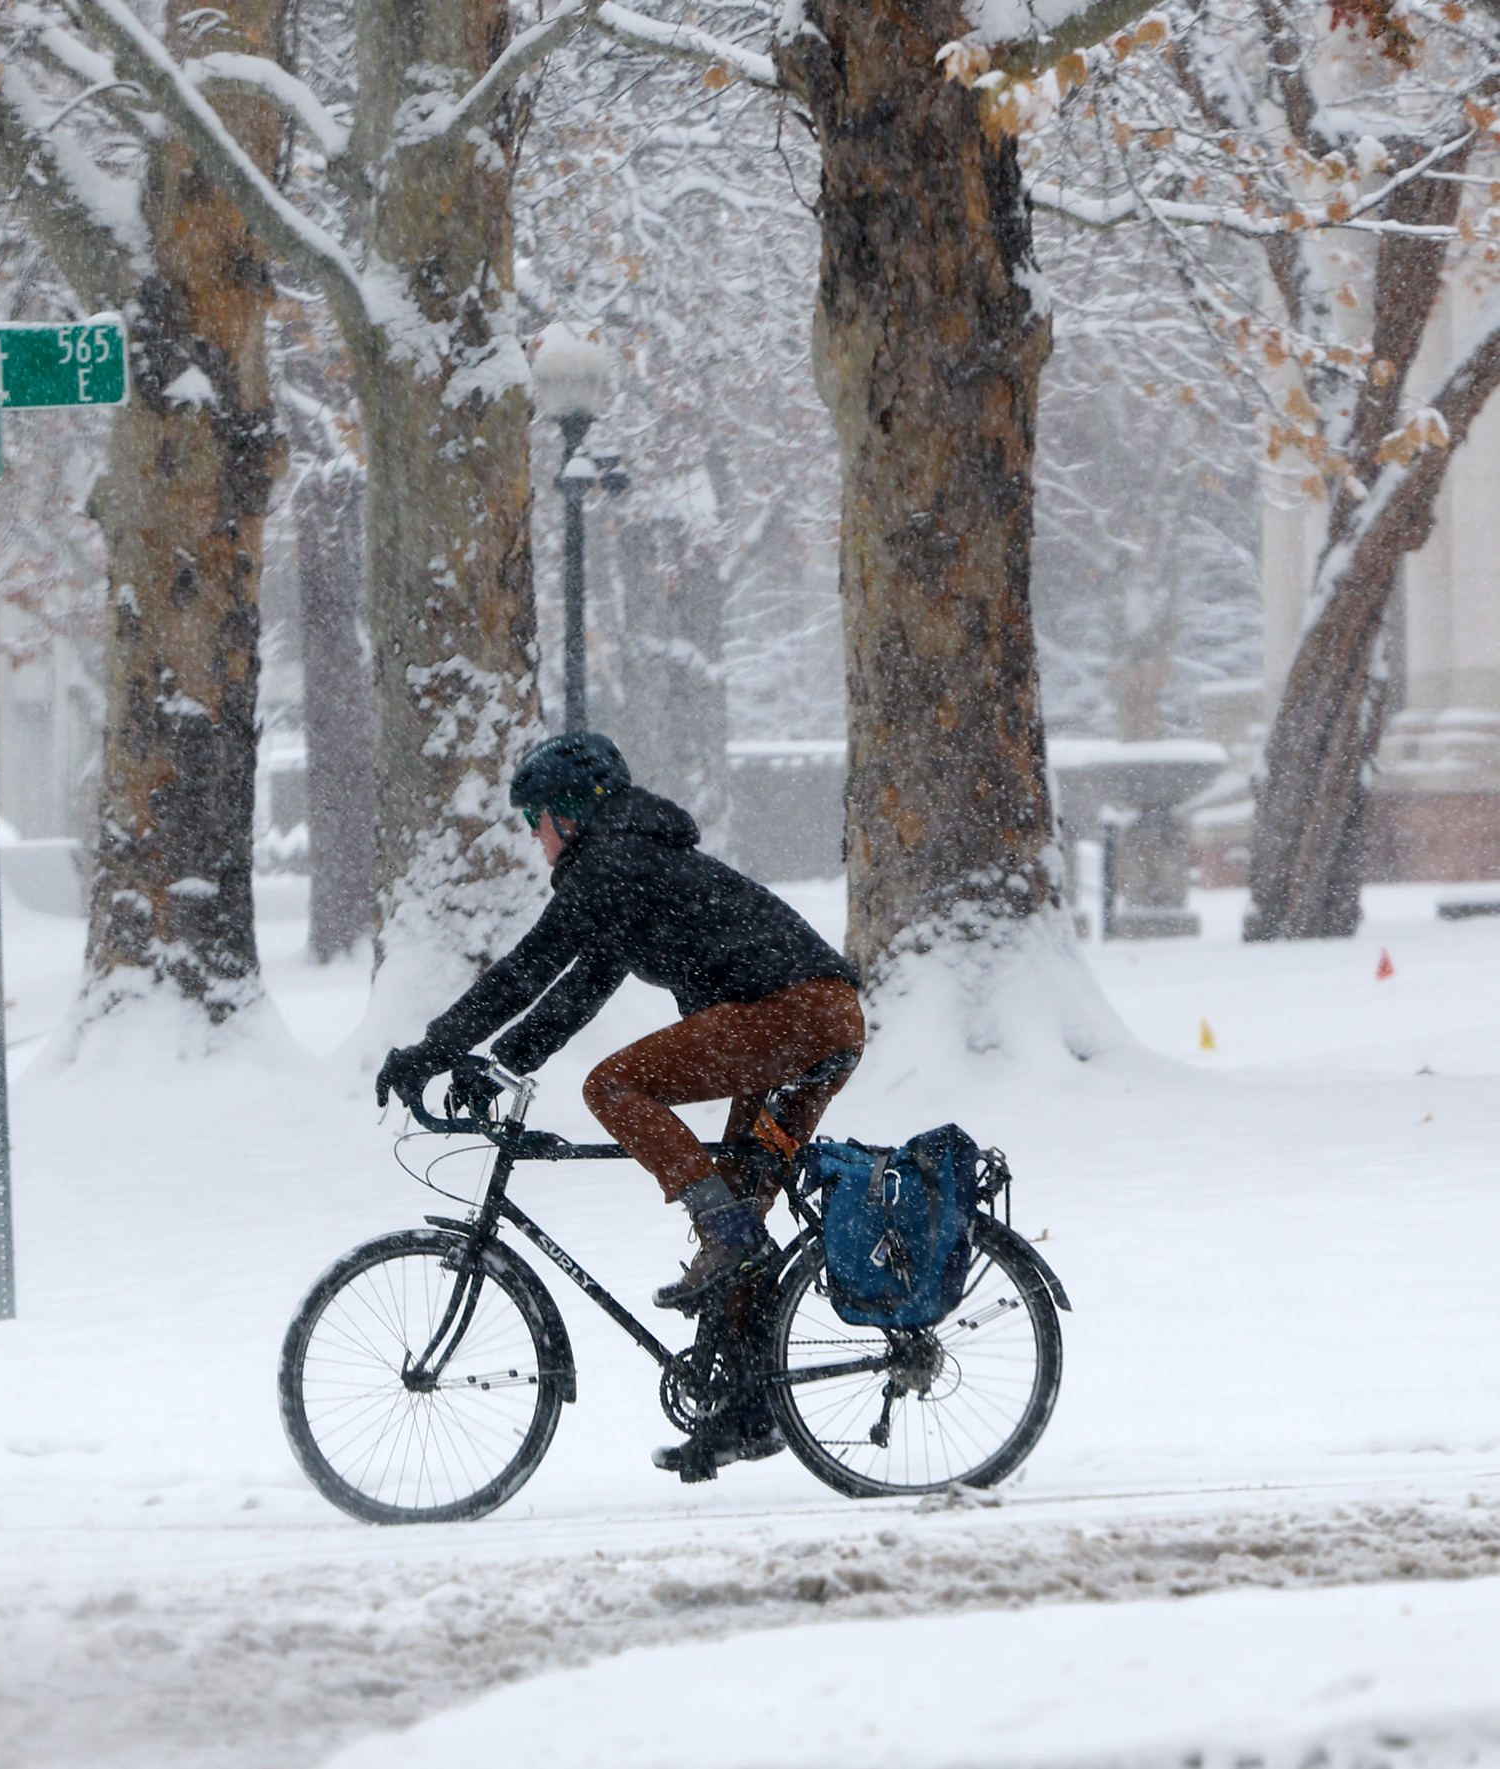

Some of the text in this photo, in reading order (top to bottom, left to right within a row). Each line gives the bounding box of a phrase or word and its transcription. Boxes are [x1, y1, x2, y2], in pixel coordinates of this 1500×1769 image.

[58, 328, 109, 364] 565
[78, 368, 93, 402] E
[537, 1235, 598, 1289] SURLY
